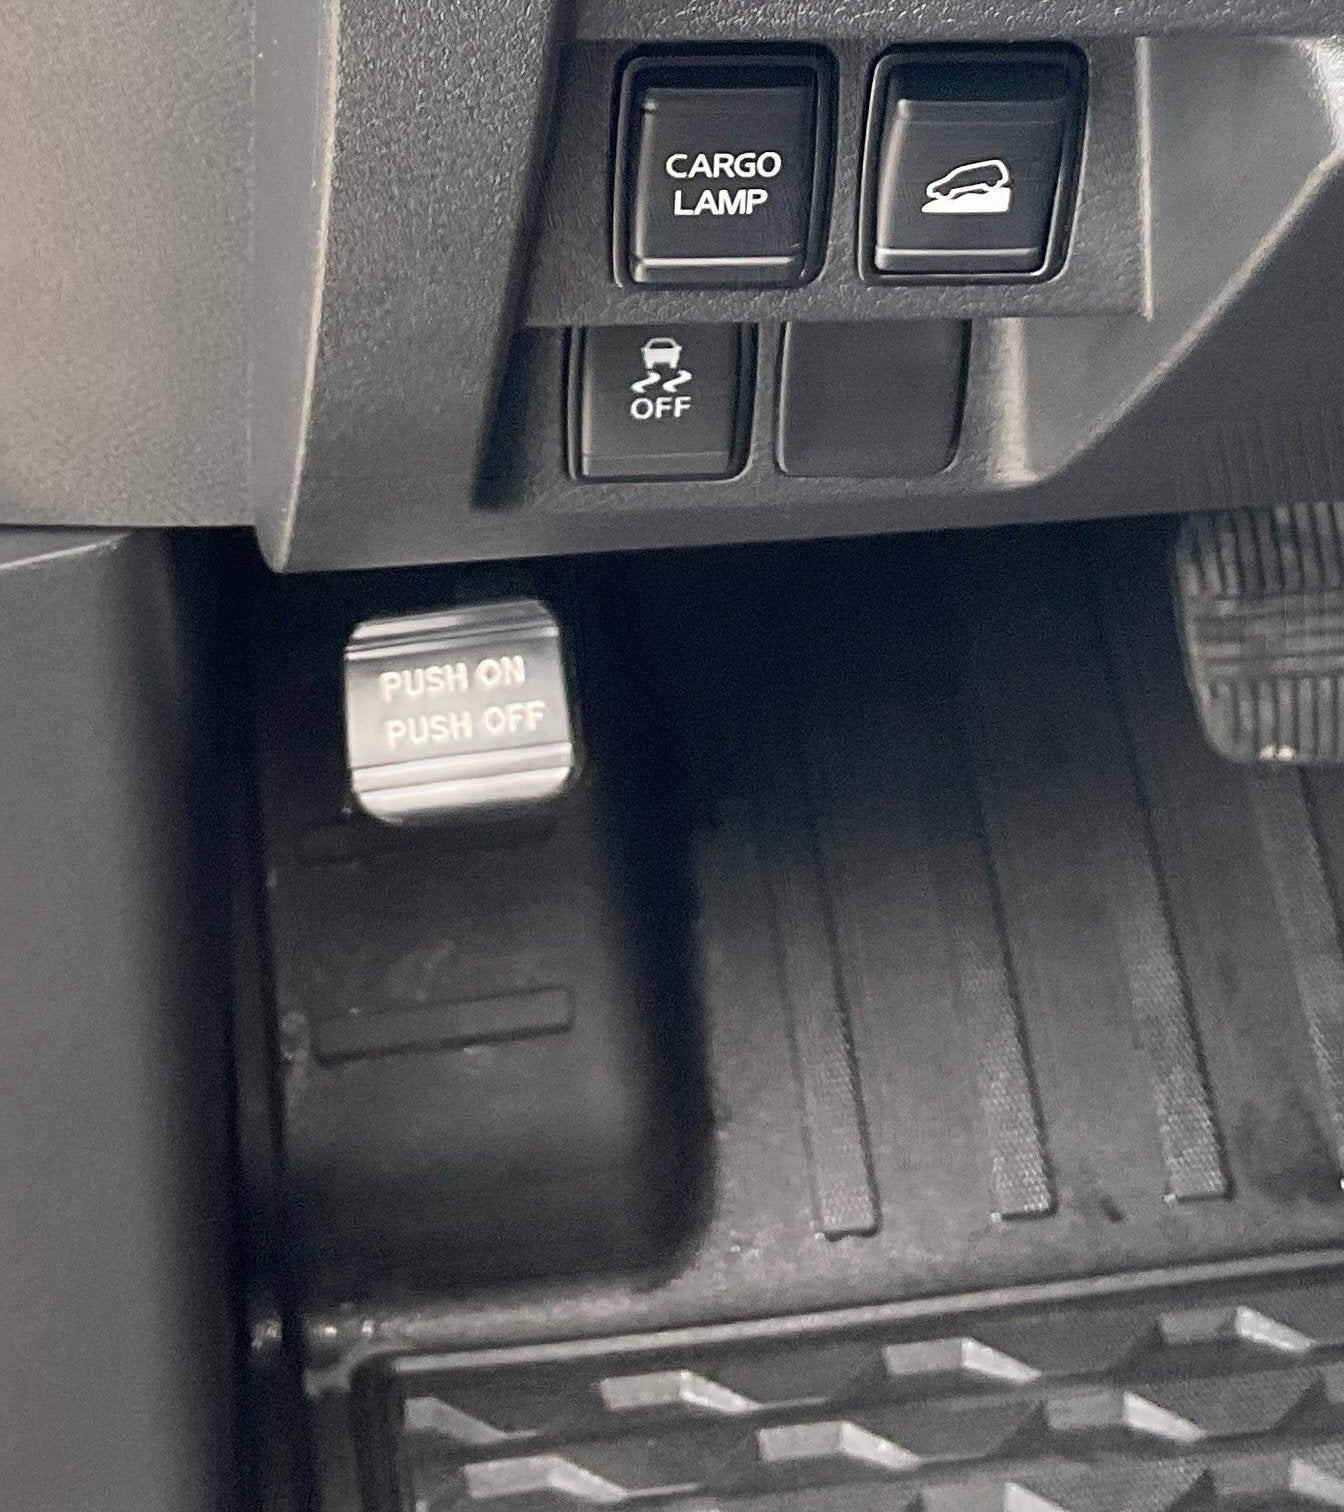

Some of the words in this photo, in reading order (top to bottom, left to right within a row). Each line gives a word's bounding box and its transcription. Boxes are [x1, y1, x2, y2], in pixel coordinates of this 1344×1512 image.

[665, 150, 782, 179] CARGO
[673, 188, 769, 217] LAMP
[629, 395, 692, 420] OFF
[378, 662, 469, 703] PUSH
[474, 654, 527, 687] ON
[385, 709, 474, 749] PUSH
[482, 699, 547, 735] OFF
